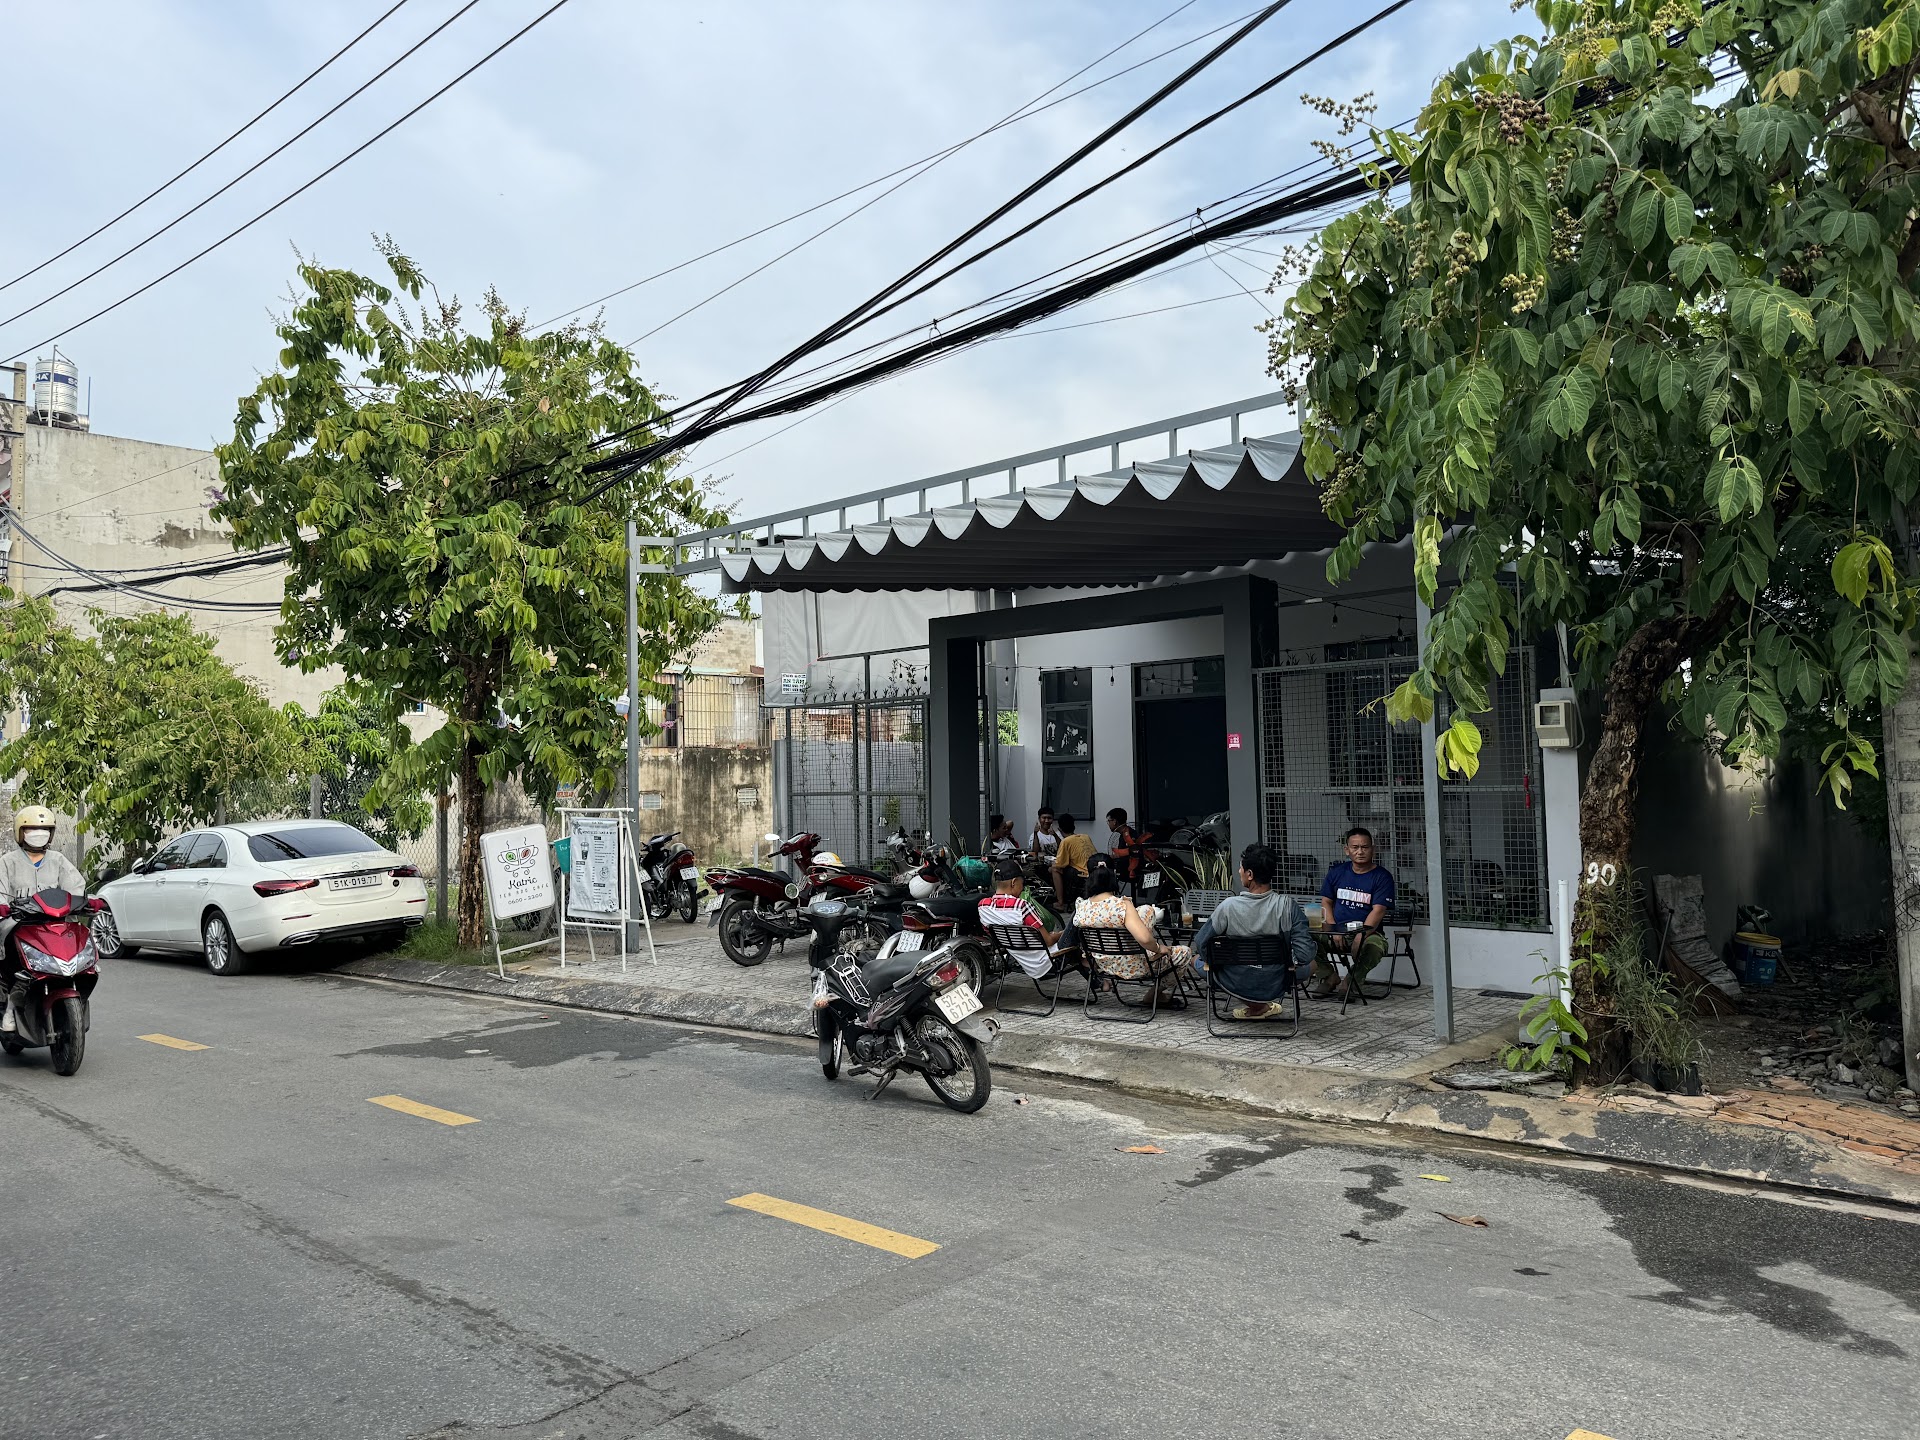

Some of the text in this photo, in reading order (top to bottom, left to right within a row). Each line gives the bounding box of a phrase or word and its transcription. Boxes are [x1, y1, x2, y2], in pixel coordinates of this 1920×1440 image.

[334, 875, 377, 888] 51K-019.77
[1587, 862, 1617, 887] 90
[940, 987, 969, 1008] 52-Y4
[949, 998, 977, 1019] 6720
